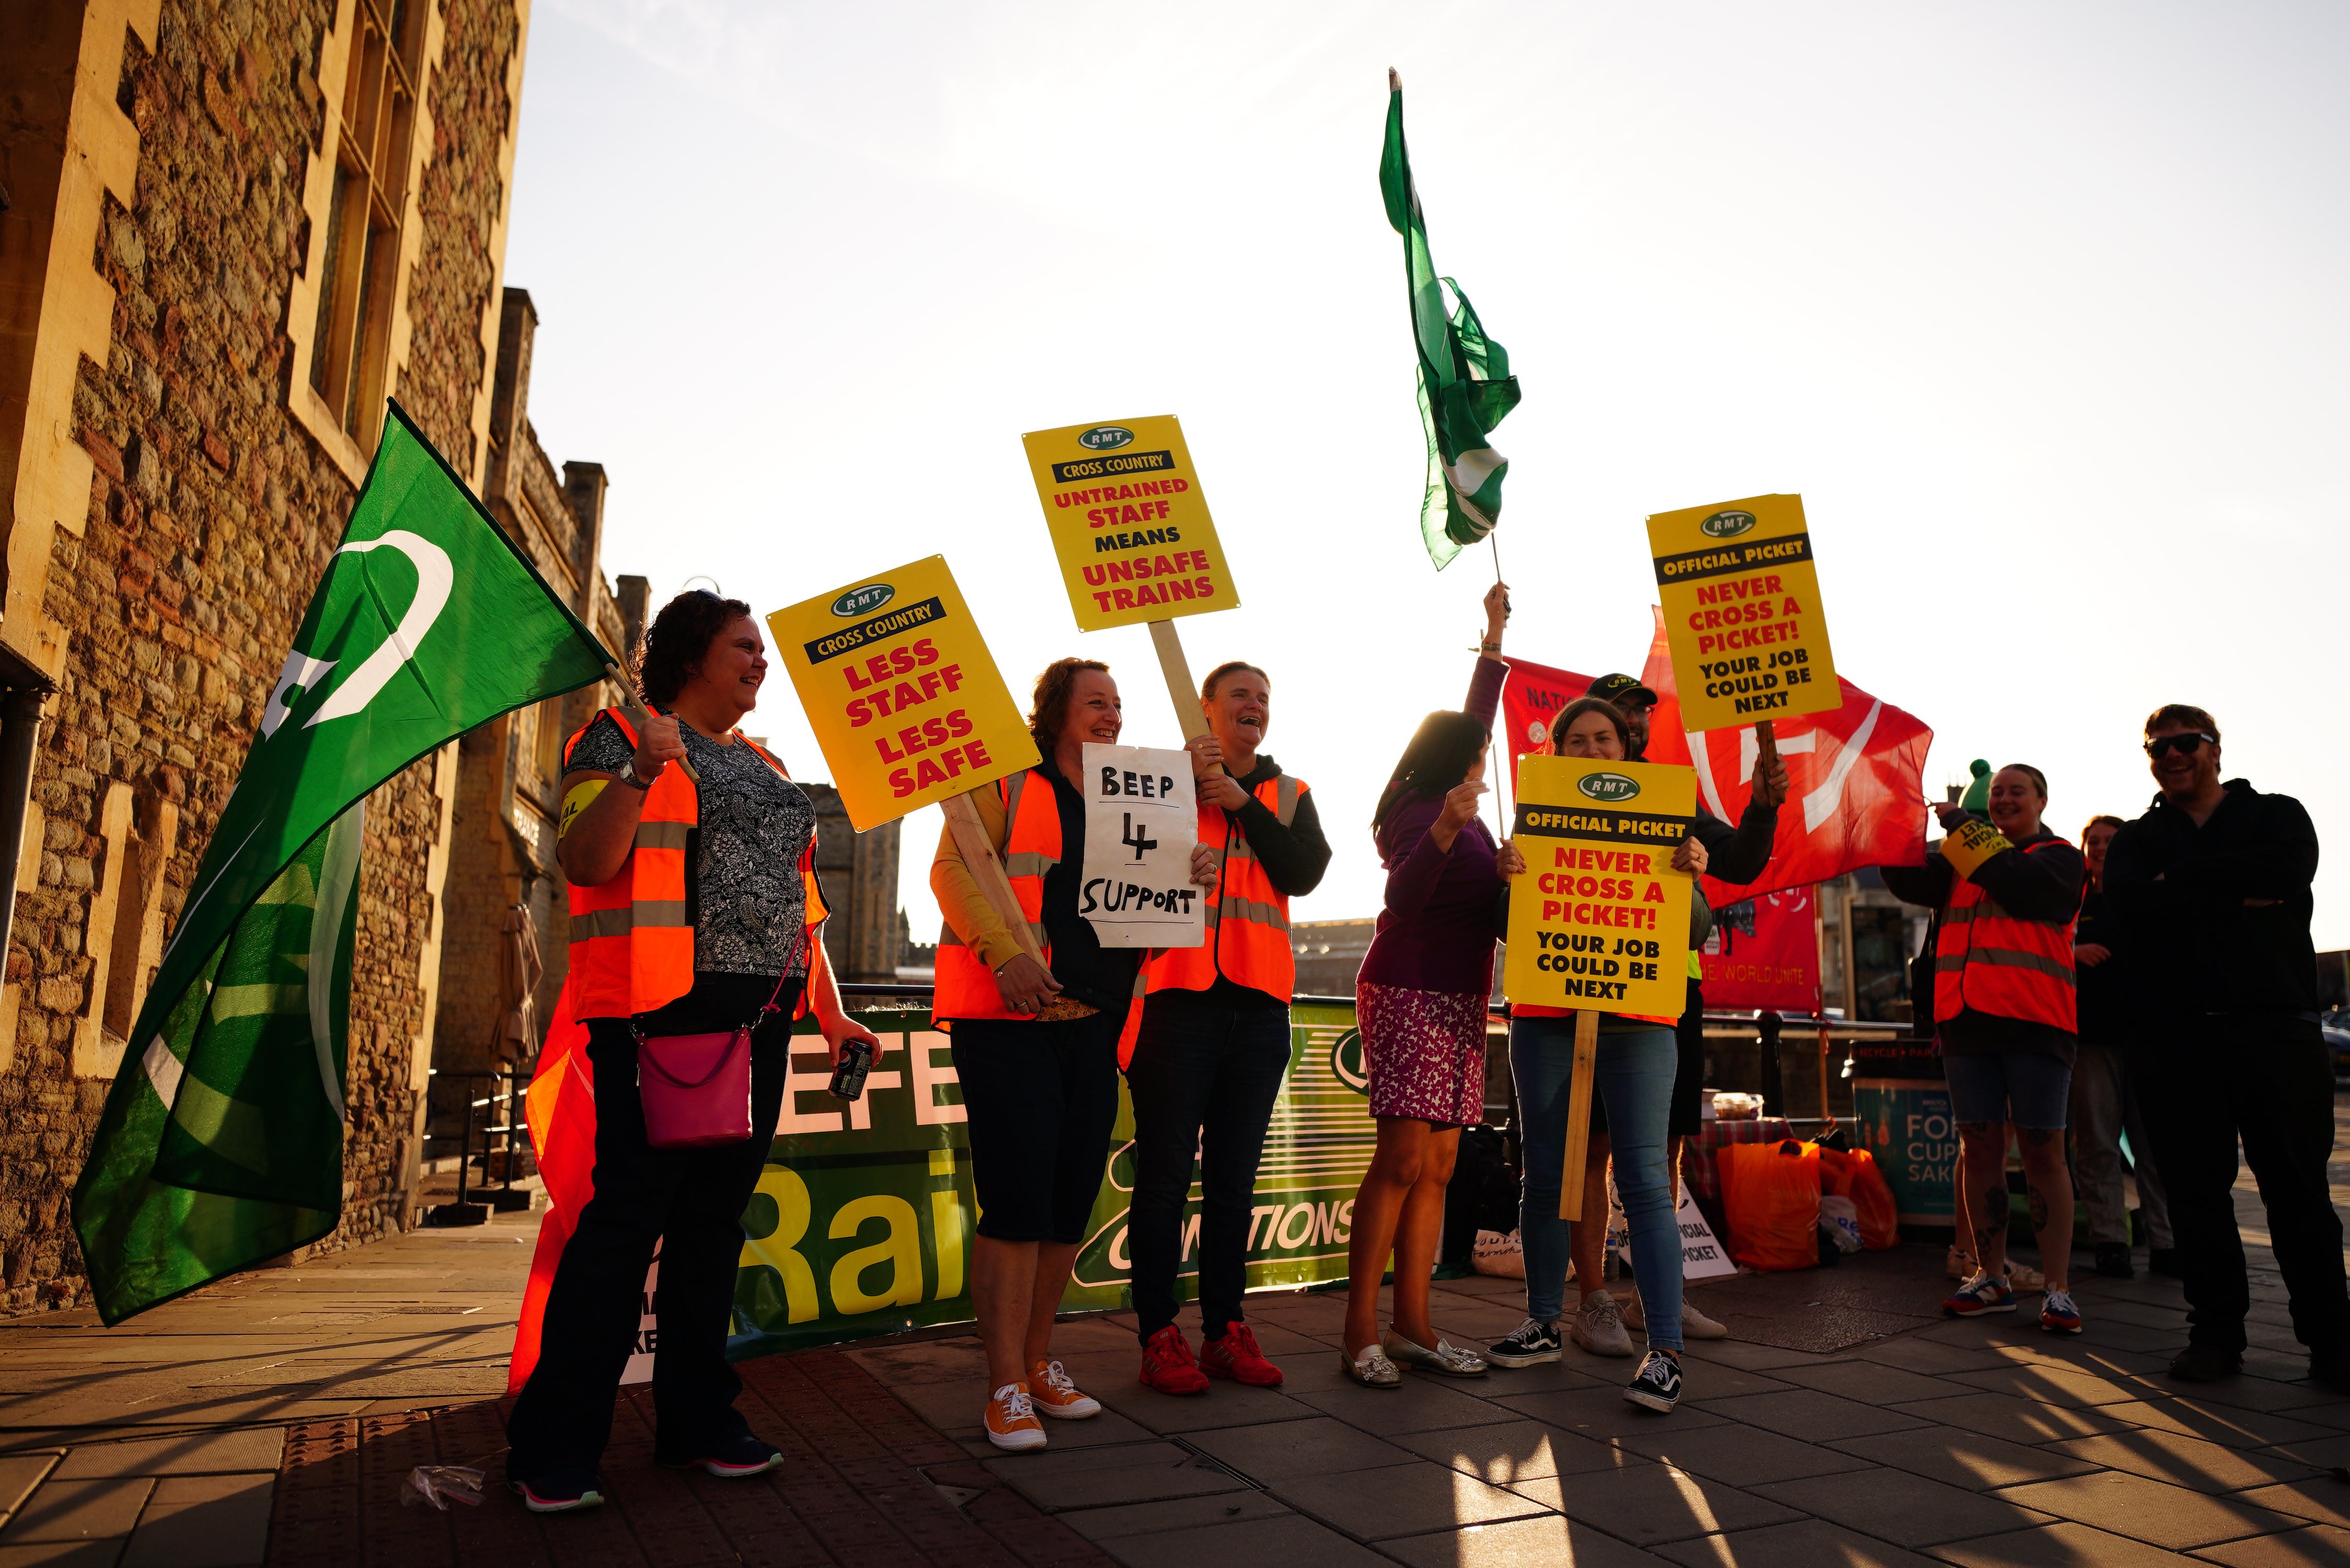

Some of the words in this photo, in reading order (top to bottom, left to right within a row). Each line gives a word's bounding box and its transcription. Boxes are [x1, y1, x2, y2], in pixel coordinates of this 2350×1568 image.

[1092, 432, 1123, 444] RMT
[1063, 463, 1103, 478] CROSS
[1106, 454, 1164, 472] COUNTRY
[1054, 478, 1189, 508] UNTRAINED
[1087, 500, 1171, 528] STAFF
[1714, 516, 1745, 532] RMT
[1095, 526, 1181, 553] MEANS
[1082, 549, 1211, 586] UNSAFE
[1663, 552, 1741, 576] OFFICIAL
[1745, 540, 1803, 563] PICKET
[846, 589, 882, 611] RMT
[1092, 576, 1215, 613] TRAINS
[1697, 575, 1784, 606] NEVER
[1688, 601, 1774, 631] CROSS
[1782, 597, 1802, 617] A
[817, 629, 863, 656] CROSS
[866, 604, 932, 637] COUNTRY
[1698, 620, 1799, 655] PICKET!
[843, 638, 939, 692] LESS
[1699, 656, 1760, 679] YOUR
[1768, 648, 1809, 668] JOB
[846, 663, 963, 728] STAFF
[1706, 673, 1779, 698] COULD
[1785, 667, 1812, 685] BE
[1735, 691, 1789, 714] NEXT
[874, 709, 973, 765] LESS
[889, 739, 992, 798] SAFE
[1101, 766, 1173, 799] BEEP
[1592, 780, 1628, 793] RMT
[1122, 812, 1157, 860] 4
[1526, 812, 1612, 833] OFFICIAL
[1618, 819, 1686, 838] PICKET
[1554, 847, 1652, 875] NEVER
[1080, 878, 1196, 914] SUPPORT
[1538, 873, 1634, 901] CROSS
[1642, 882, 1666, 903] A
[1542, 900, 1656, 930] PICKET!
[1536, 931, 1605, 954] YOUR
[1612, 938, 1660, 958] JOB
[1537, 954, 1620, 977] COULD
[1629, 962, 1658, 981] BE
[1723, 964, 1771, 983] WORLD
[1775, 967, 1804, 986] UNITE
[1564, 978, 1628, 1000] NEXT
[727, 1148, 983, 1336] Rai
